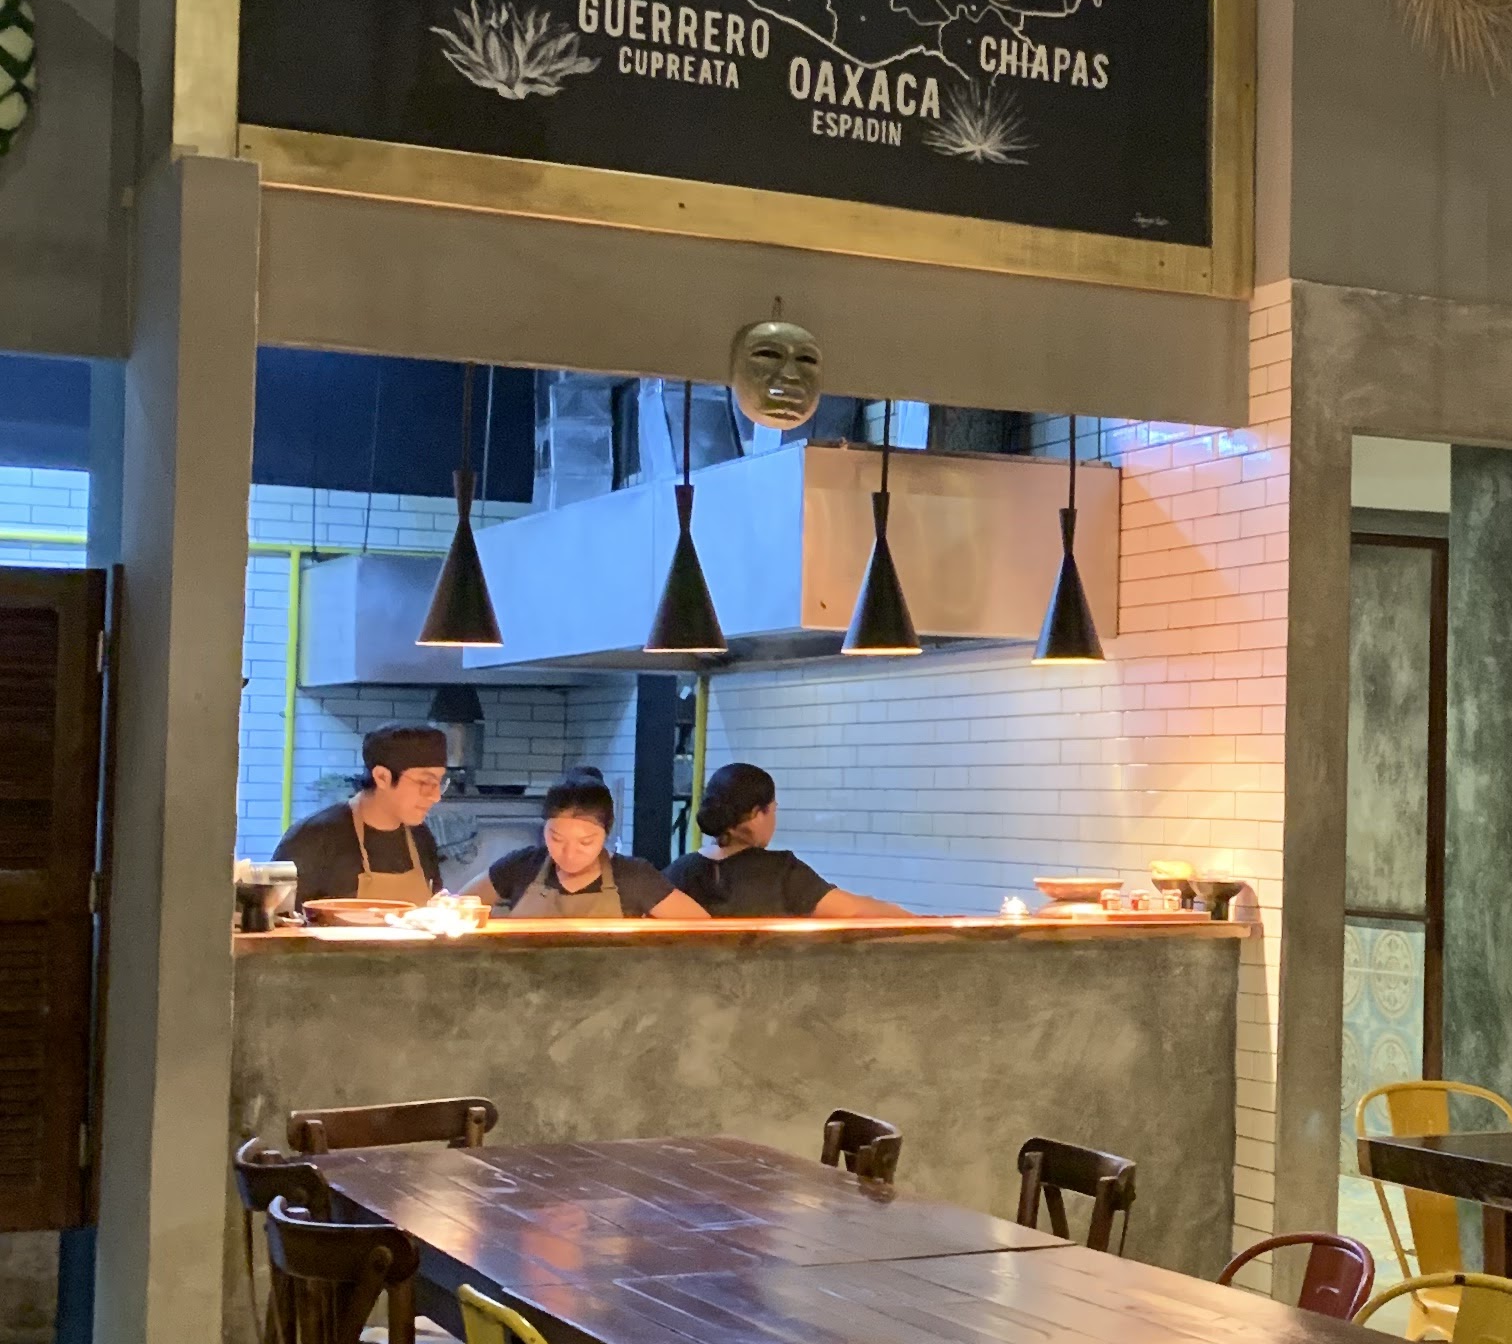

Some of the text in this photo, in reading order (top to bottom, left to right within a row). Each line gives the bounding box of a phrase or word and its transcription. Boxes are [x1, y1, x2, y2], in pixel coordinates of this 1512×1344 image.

[619, 45, 740, 89] CUPREATA
[979, 35, 1110, 90] CHIAPAS
[788, 56, 942, 119] OAXACA
[812, 109, 901, 147] ESPADIN
